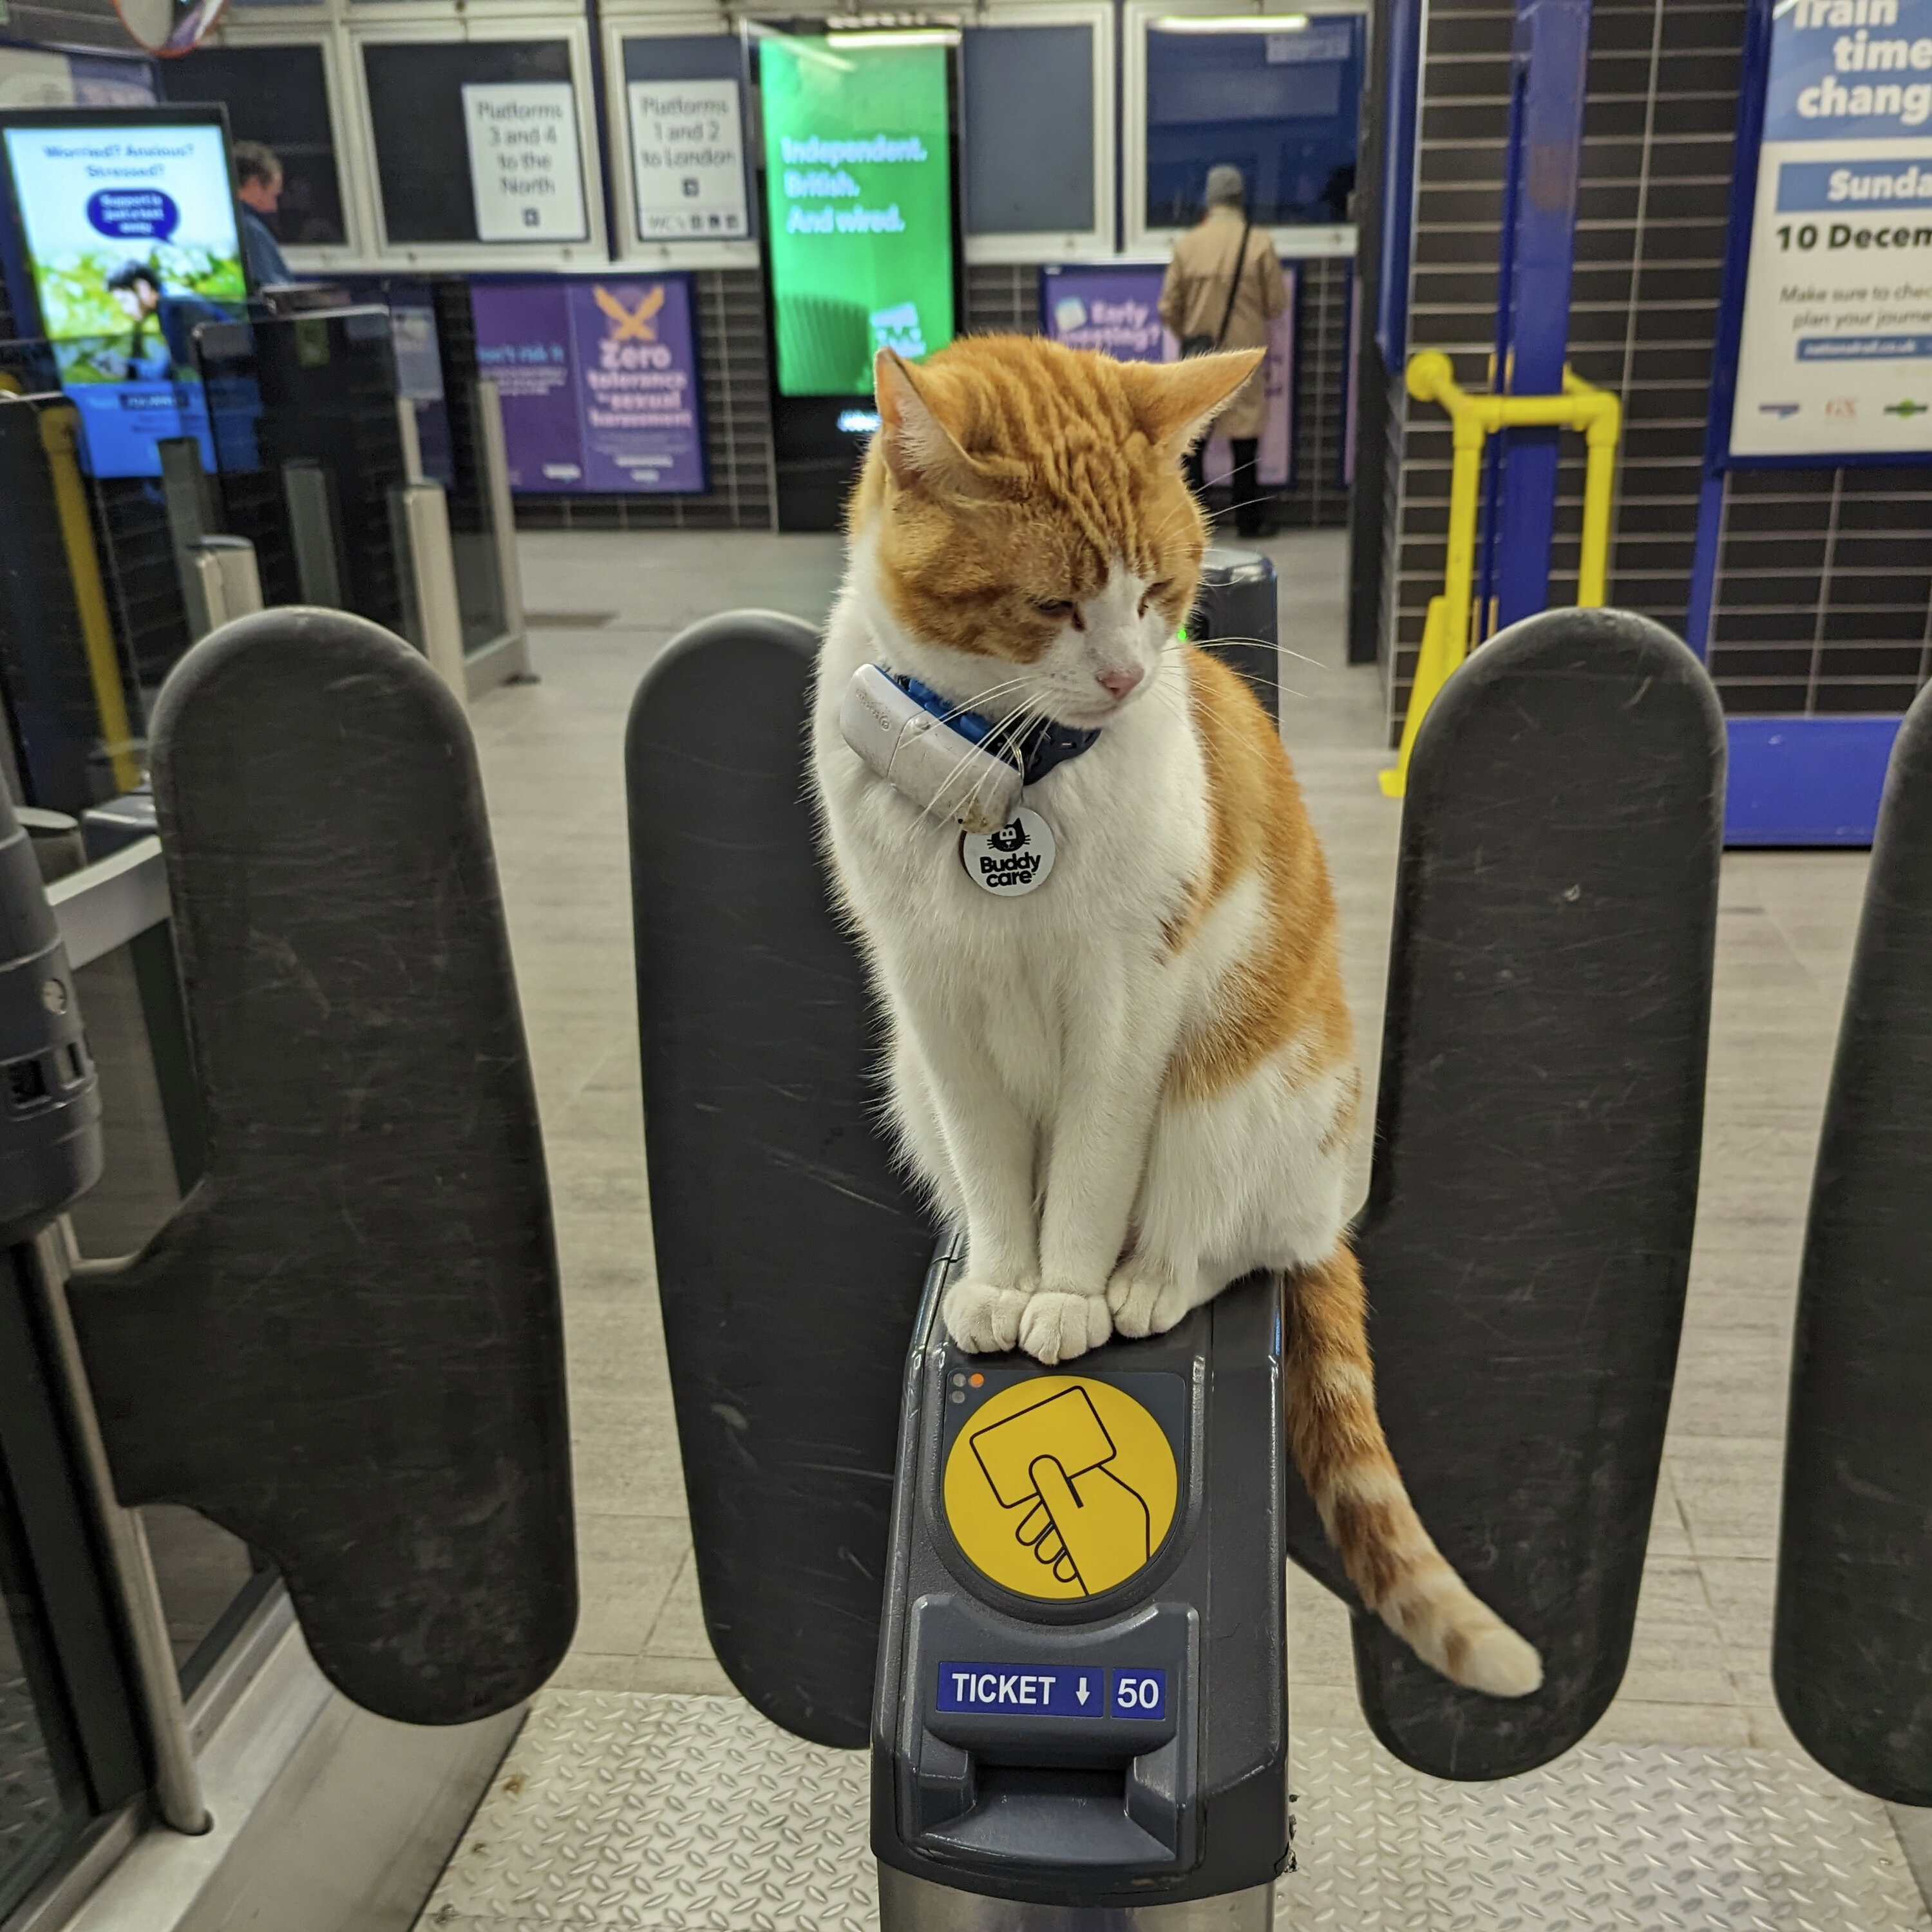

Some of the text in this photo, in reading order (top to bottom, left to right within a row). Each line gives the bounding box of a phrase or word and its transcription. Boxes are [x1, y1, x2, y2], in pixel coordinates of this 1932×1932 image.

[477, 101, 563, 120] Platforms
[641, 97, 730, 116] Platforms
[1797, 75, 1932, 126] chang
[490, 126, 558, 146] 3 and 4
[654, 120, 720, 141] 1 and 2
[43, 142, 194, 158] Worried? Anxious?
[641, 147, 737, 167] to London
[781, 133, 928, 168] Independent.
[497, 152, 552, 170] to the
[500, 177, 556, 194] North
[783, 169, 861, 198] British.
[1827, 166, 1932, 202] Sunda
[786, 202, 906, 234] And wired.
[1776, 223, 1932, 251] 10 Decem
[1780, 285, 1827, 303] Make
[1833, 289, 1868, 303] sure
[1871, 287, 1890, 301] to
[1091, 299, 1148, 330] Early
[1792, 310, 1830, 332] plan
[1834, 313, 1873, 332] your
[599, 339, 672, 370] Zero
[587, 369, 687, 390] tolerance
[611, 390, 681, 409] sexual
[589, 408, 693, 427] harassment
[980, 851, 1041, 874] Buddy
[986, 870, 1033, 887] care
[951, 1673, 1056, 1705] TICKET
[1117, 1678, 1159, 1709] 50
